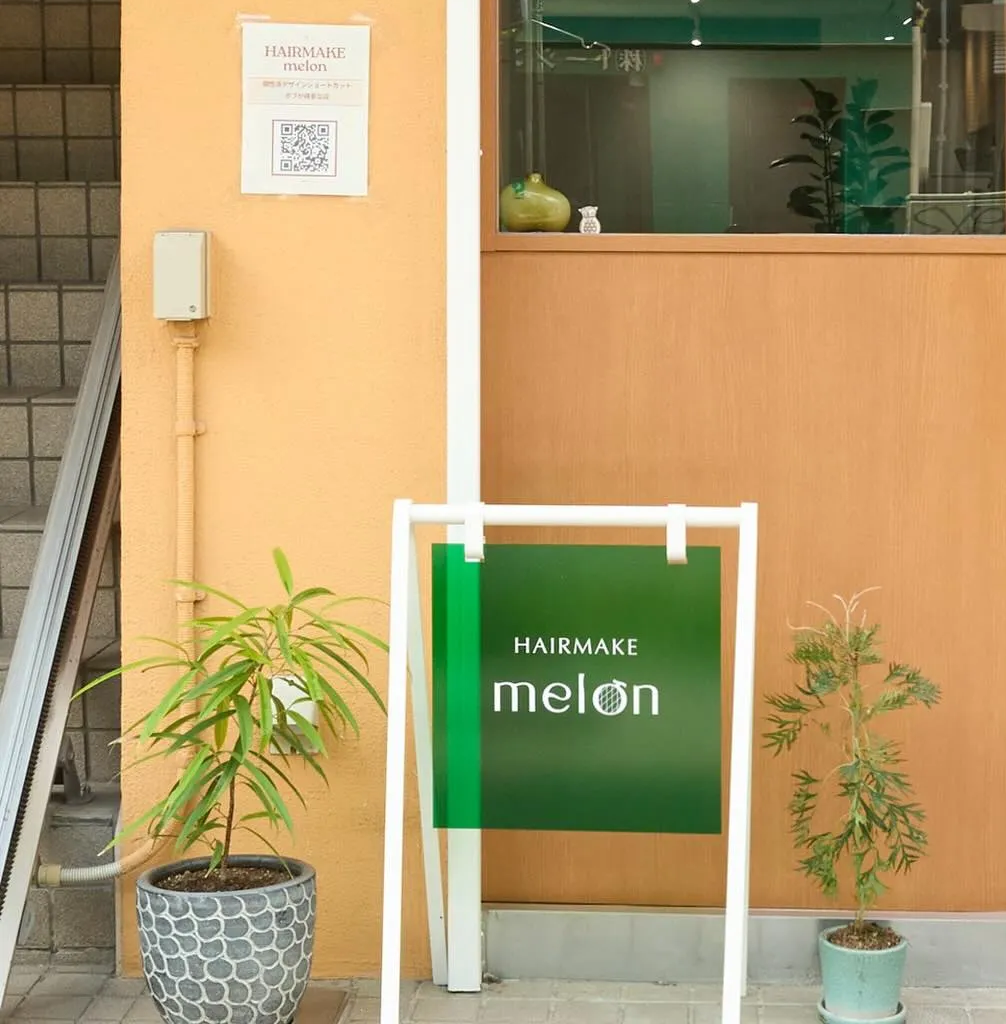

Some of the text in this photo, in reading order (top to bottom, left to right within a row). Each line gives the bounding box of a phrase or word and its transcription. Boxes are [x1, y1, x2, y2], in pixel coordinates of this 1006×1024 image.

[265, 45, 346, 59] HAIRMAKE
[283, 60, 328, 72] melon
[514, 636, 638, 656] HAIRMAKE
[493, 673, 660, 716] melon
